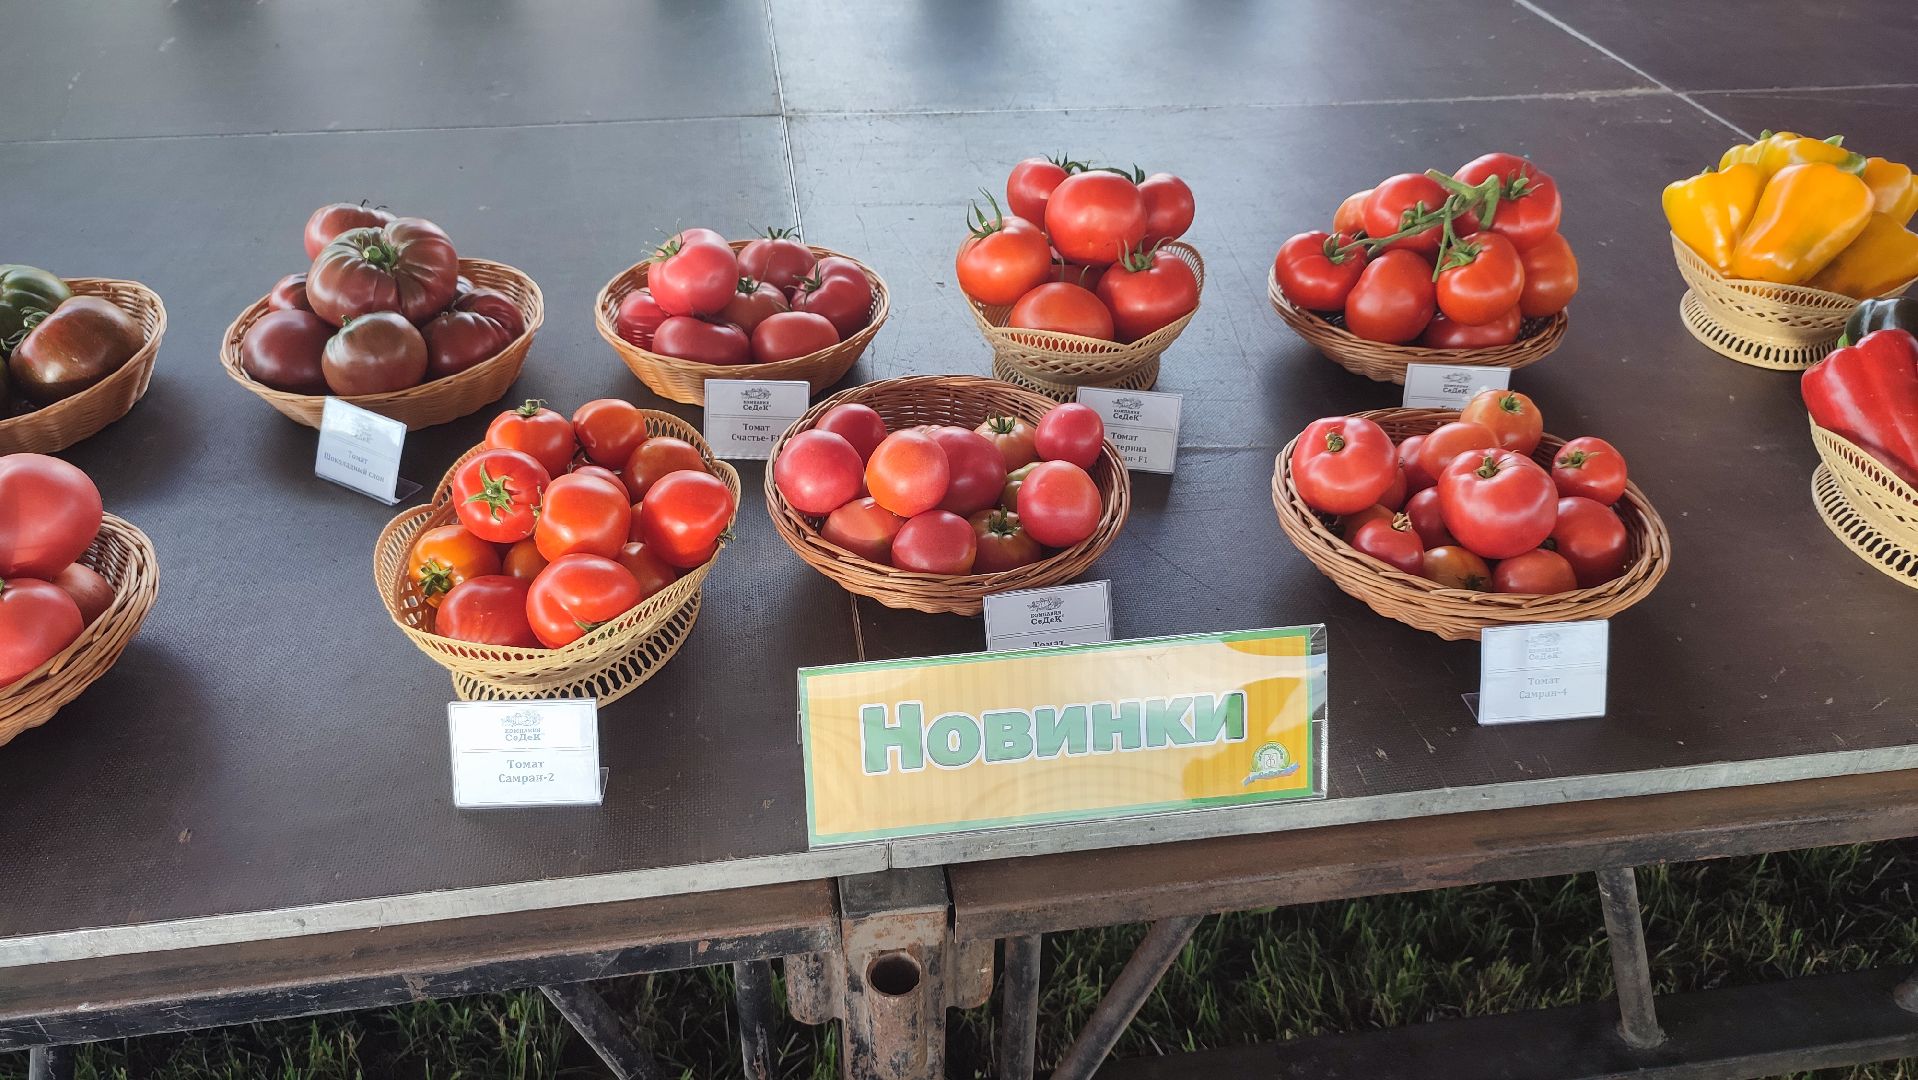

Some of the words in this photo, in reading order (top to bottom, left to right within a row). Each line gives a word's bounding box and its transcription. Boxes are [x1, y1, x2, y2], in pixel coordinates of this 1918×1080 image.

[1113, 413, 1140, 421] СеДеК
[742, 423, 770, 431] Томат
[1111, 432, 1138, 441] Томат
[348, 450, 368, 464] Томат
[324, 452, 368, 475] Шоколадный
[368, 470, 385, 482] слон
[1030, 616, 1063, 625] СеДеК
[1528, 678, 1560, 686] Томат
[861, 691, 1247, 775] Новинки
[505, 734, 542, 742] СеДеК
[506, 760, 544, 768] Томат
